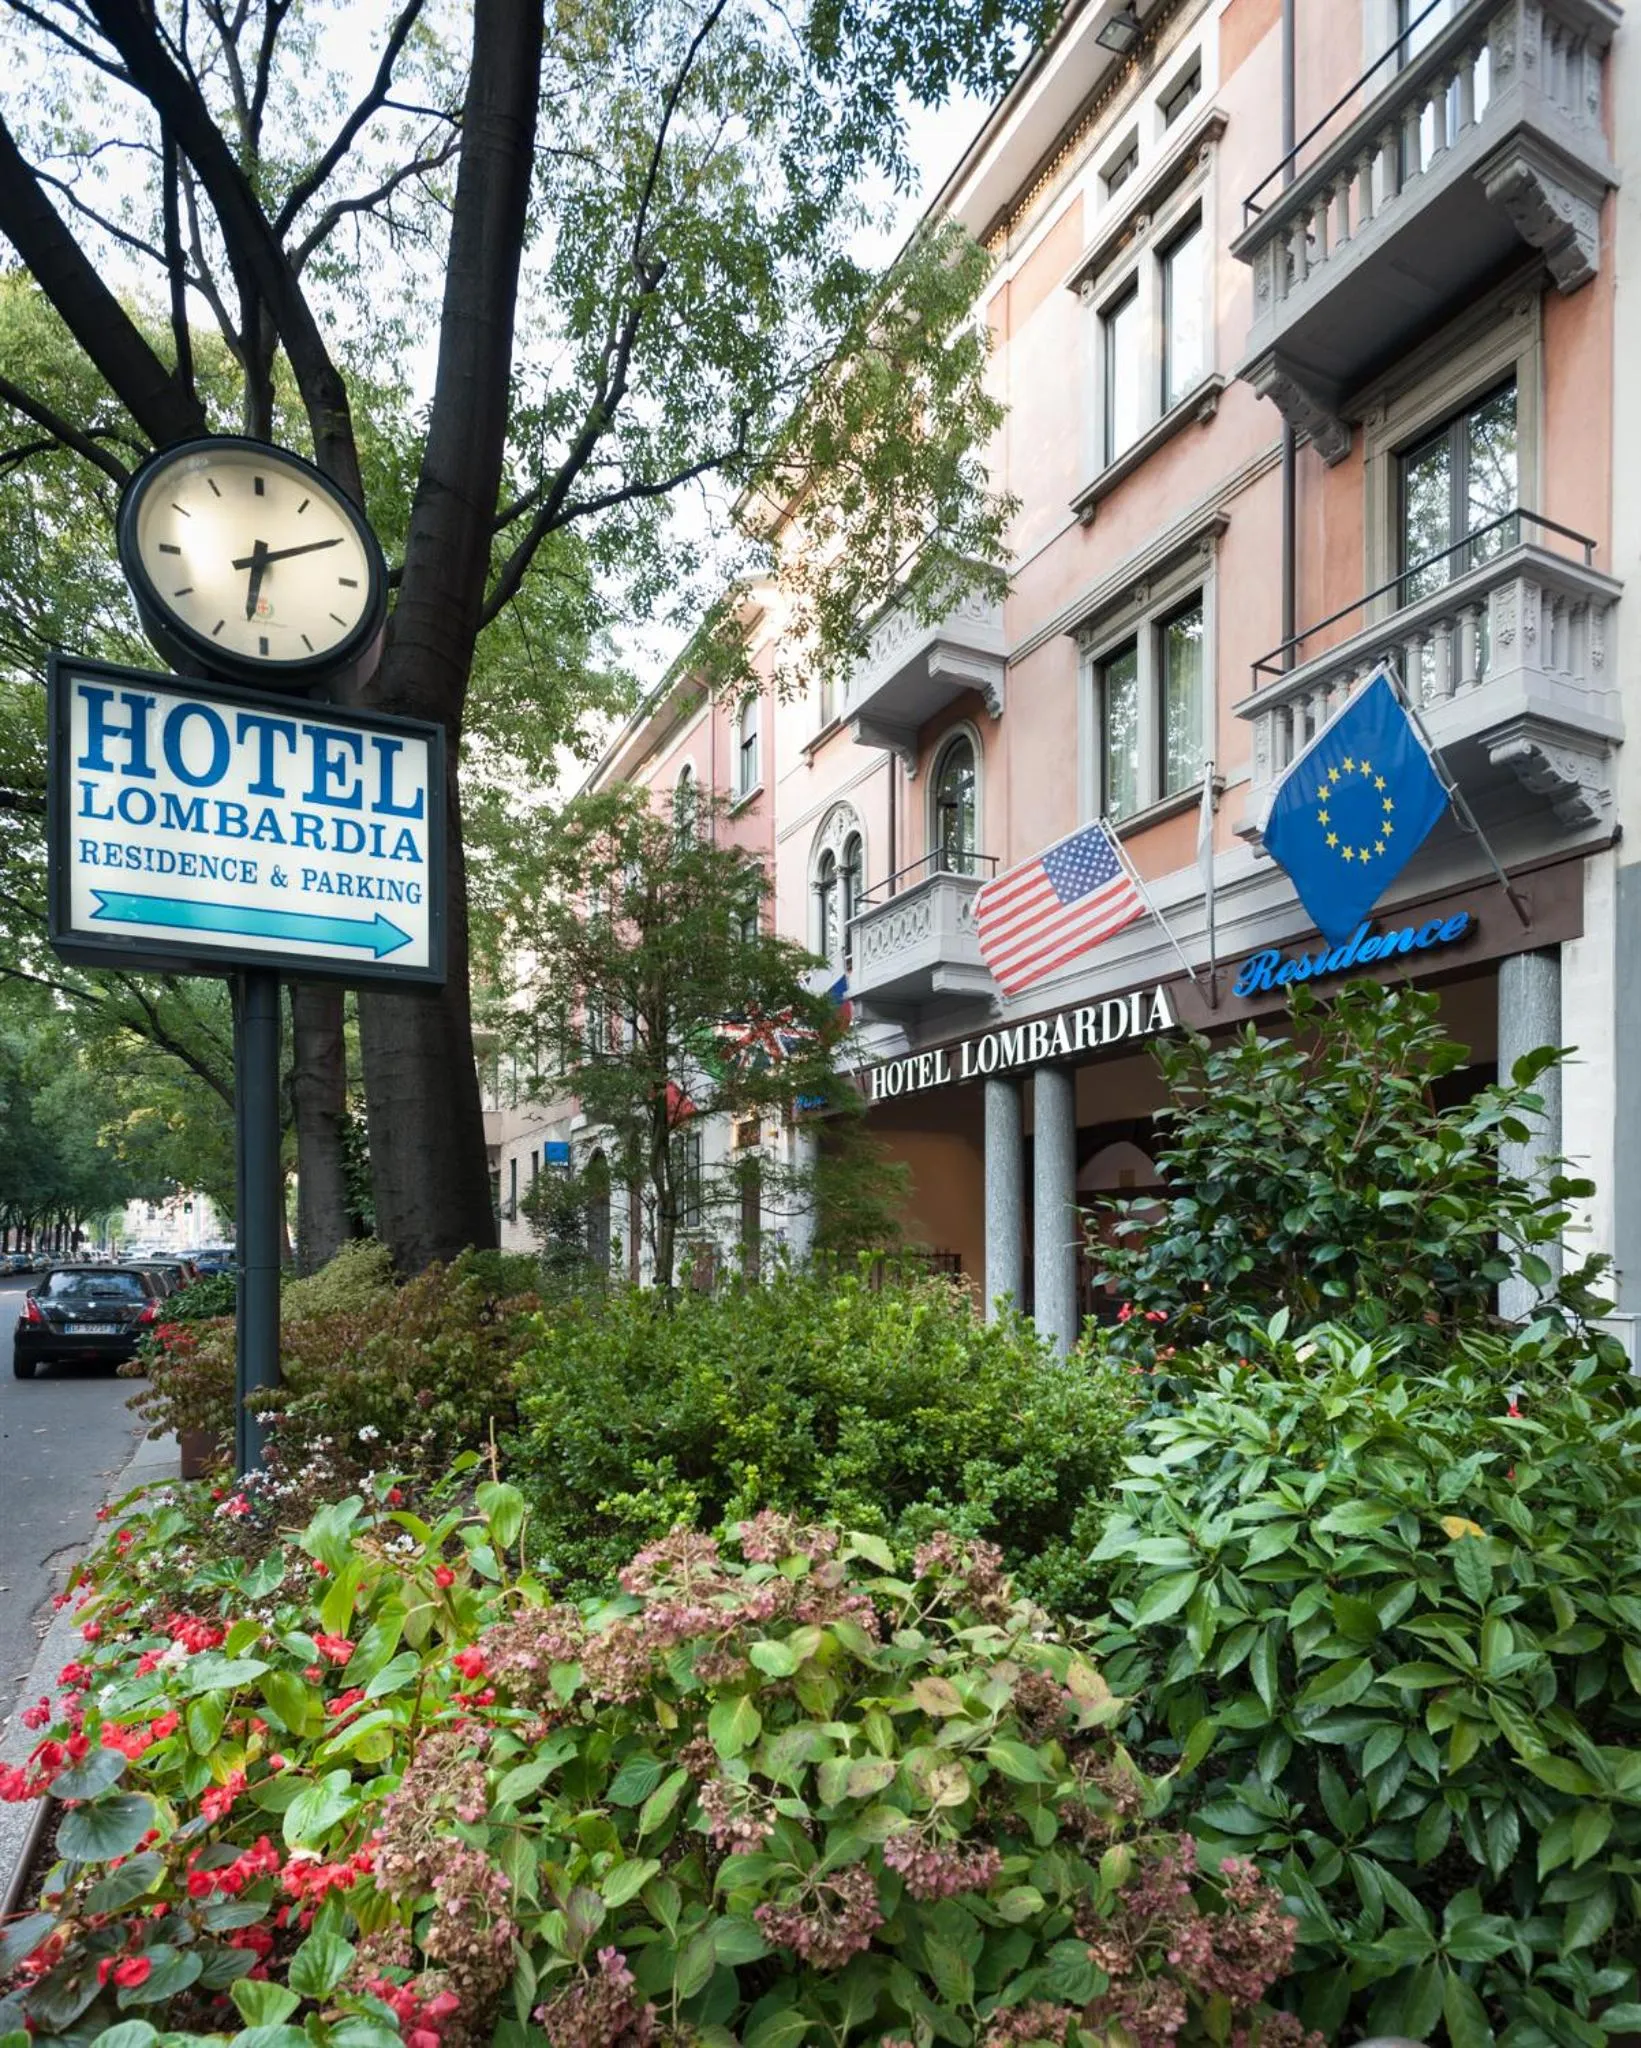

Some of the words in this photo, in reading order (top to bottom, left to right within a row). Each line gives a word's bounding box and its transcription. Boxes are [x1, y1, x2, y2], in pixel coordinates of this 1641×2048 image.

[78, 685, 424, 820] HOTEL
[78, 780, 424, 864] LOMBARDIA
[79, 839, 258, 884] RESIDENCE
[270, 865, 288, 888] &
[301, 868, 422, 904] PARKING
[1232, 911, 1470, 998] Residence
[871, 1049, 951, 1100] HOTEL
[960, 984, 1175, 1078] LOMBARDIA
